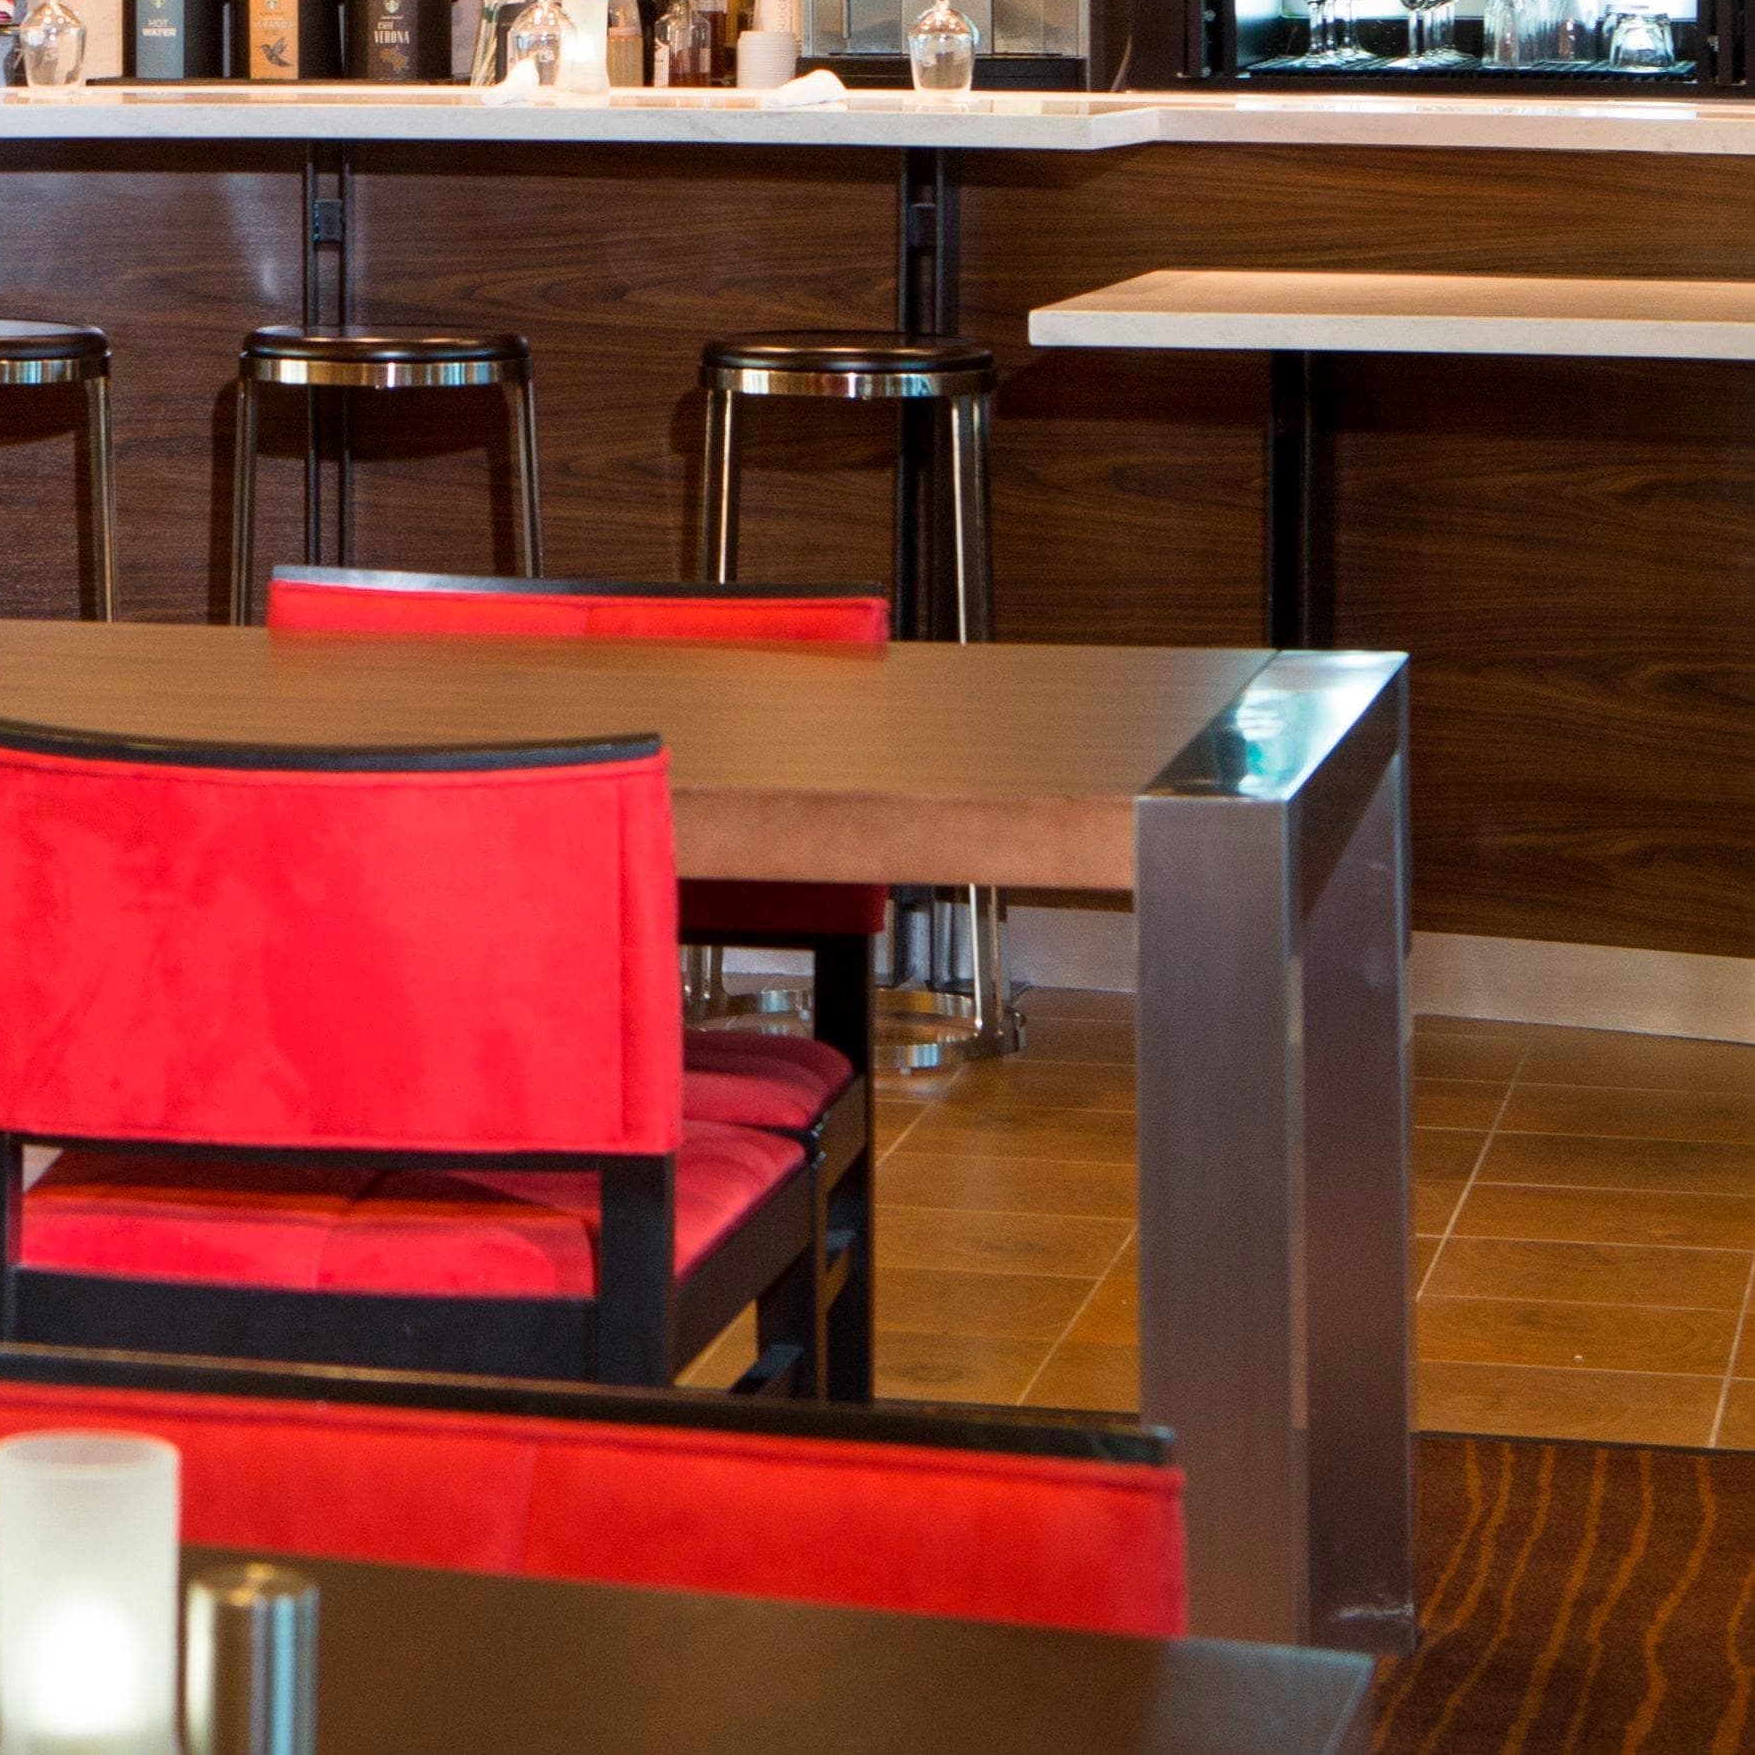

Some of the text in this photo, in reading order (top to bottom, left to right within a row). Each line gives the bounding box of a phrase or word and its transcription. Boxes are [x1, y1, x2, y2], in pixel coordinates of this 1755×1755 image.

[148, 19, 168, 28] HOT
[142, 28, 177, 37] WATER
[374, 30, 410, 44] VERONA
